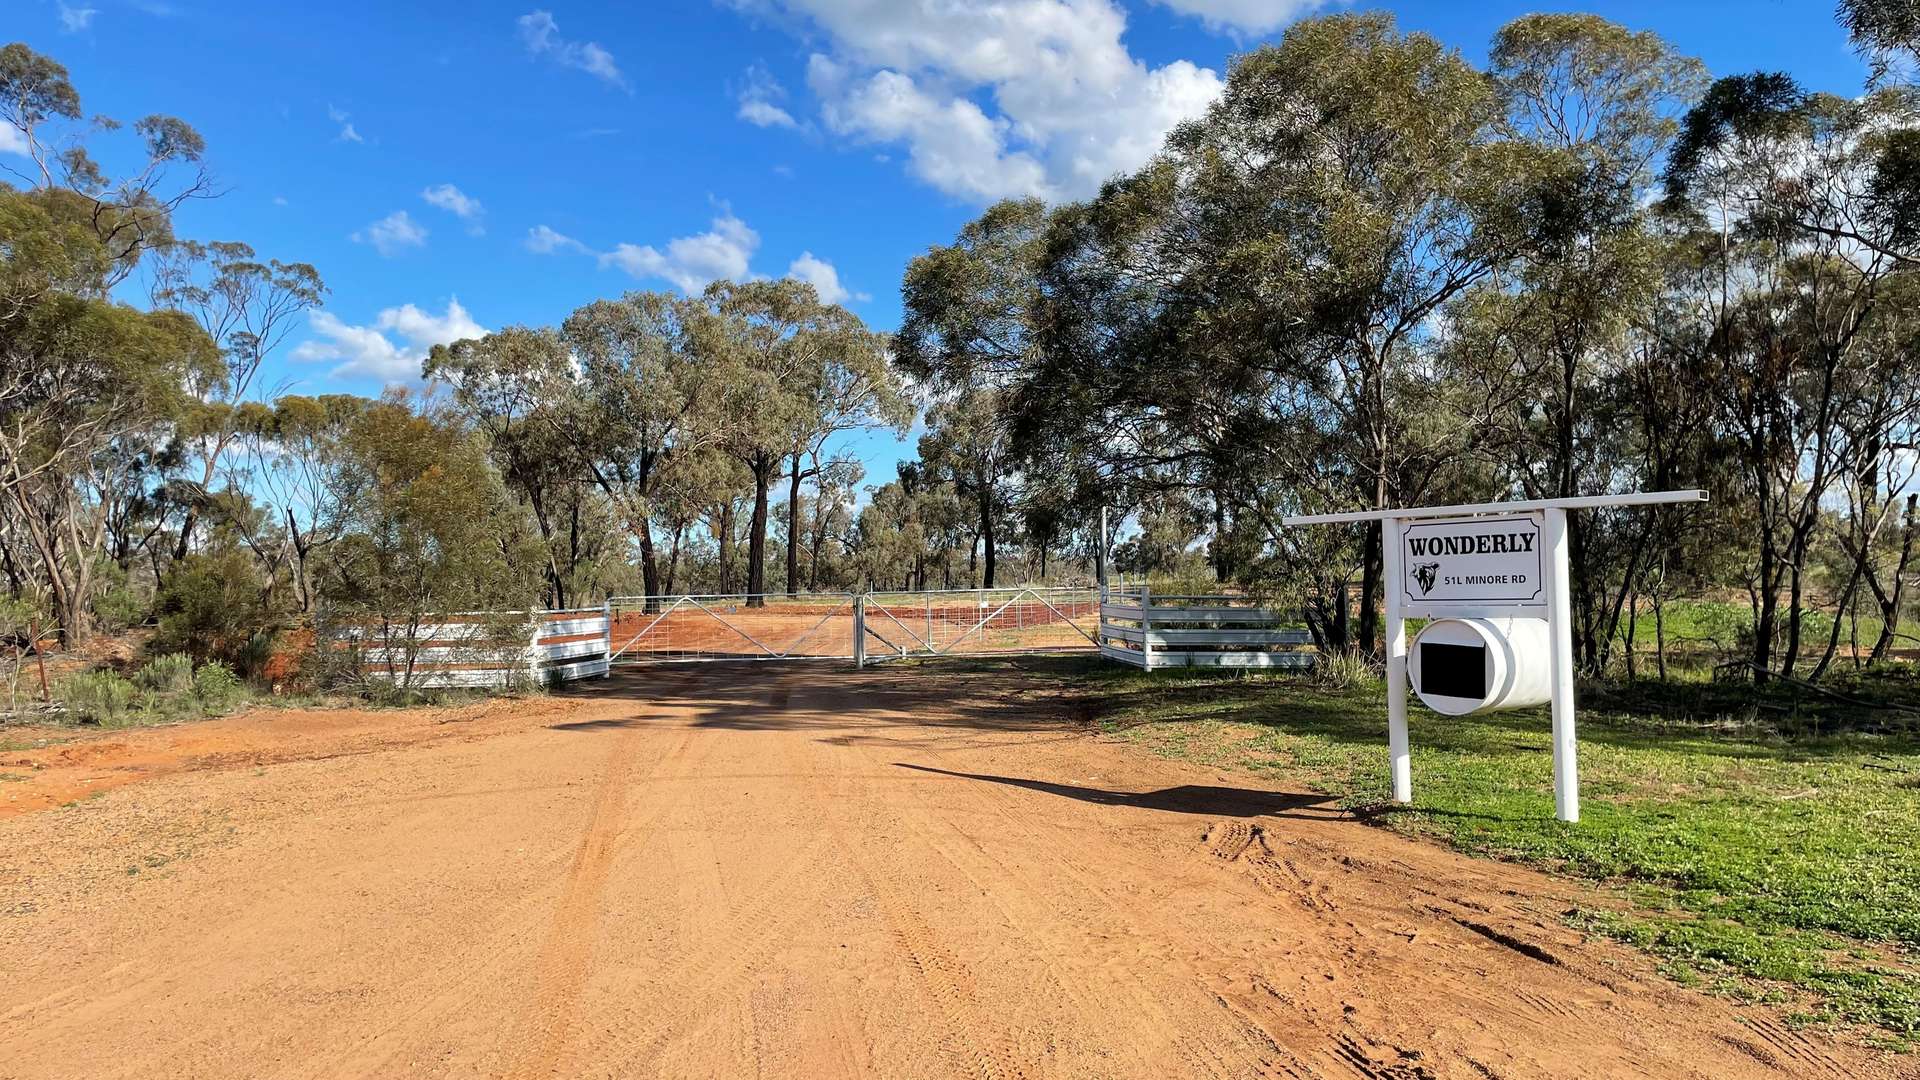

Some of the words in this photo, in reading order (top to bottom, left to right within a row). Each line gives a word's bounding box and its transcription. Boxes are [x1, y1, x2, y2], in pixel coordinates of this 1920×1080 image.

[1408, 533, 1536, 556] WONDERLY
[1444, 576, 1463, 585] 51L
[1465, 575, 1508, 585] MINORE
[1511, 575, 1527, 584] RD
